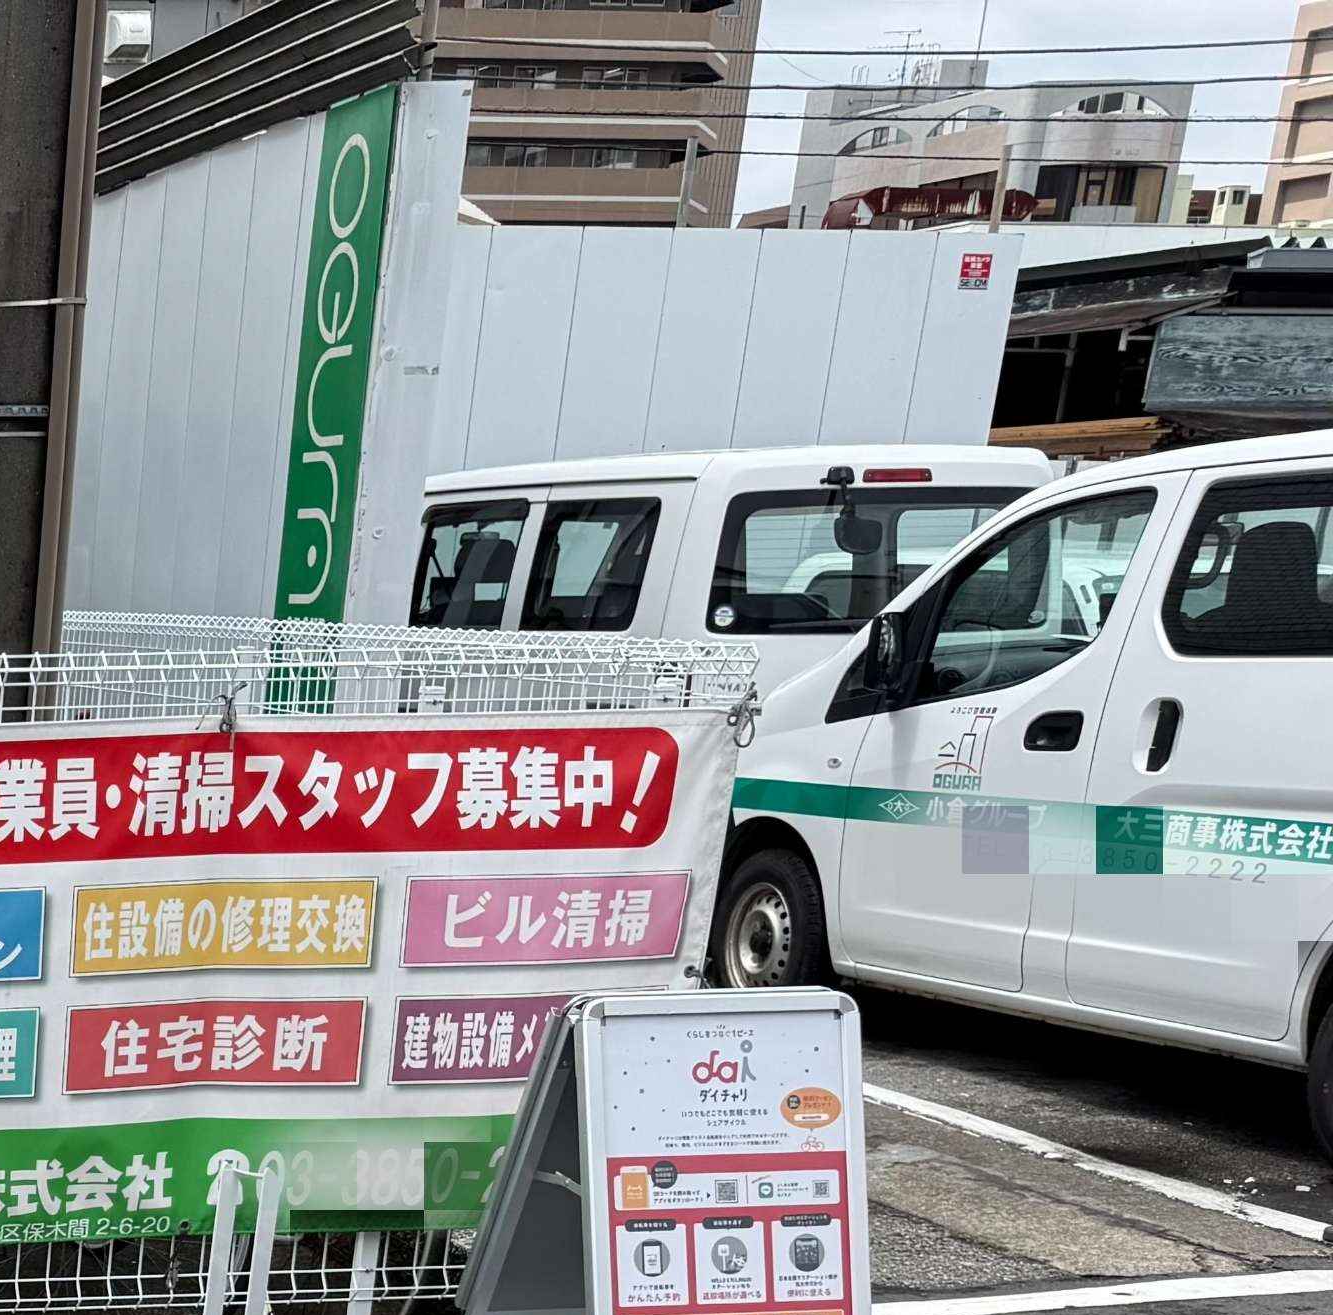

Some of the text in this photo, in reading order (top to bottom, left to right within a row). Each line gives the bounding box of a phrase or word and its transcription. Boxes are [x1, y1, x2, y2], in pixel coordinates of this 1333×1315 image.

[1113, 809, 1333, 859] 大三商事株式会社
[83, 894, 365, 961] 住設備の修理交換
[444, 889, 653, 948] ビル清掃
[101, 1015, 329, 1077] 住宅診断
[402, 1011, 558, 1069] 建物設備メ
[692, 1039, 757, 1084] dai
[699, 1088, 748, 1103] ダイチャリ
[97, 1216, 170, 1235] 2-6-20
